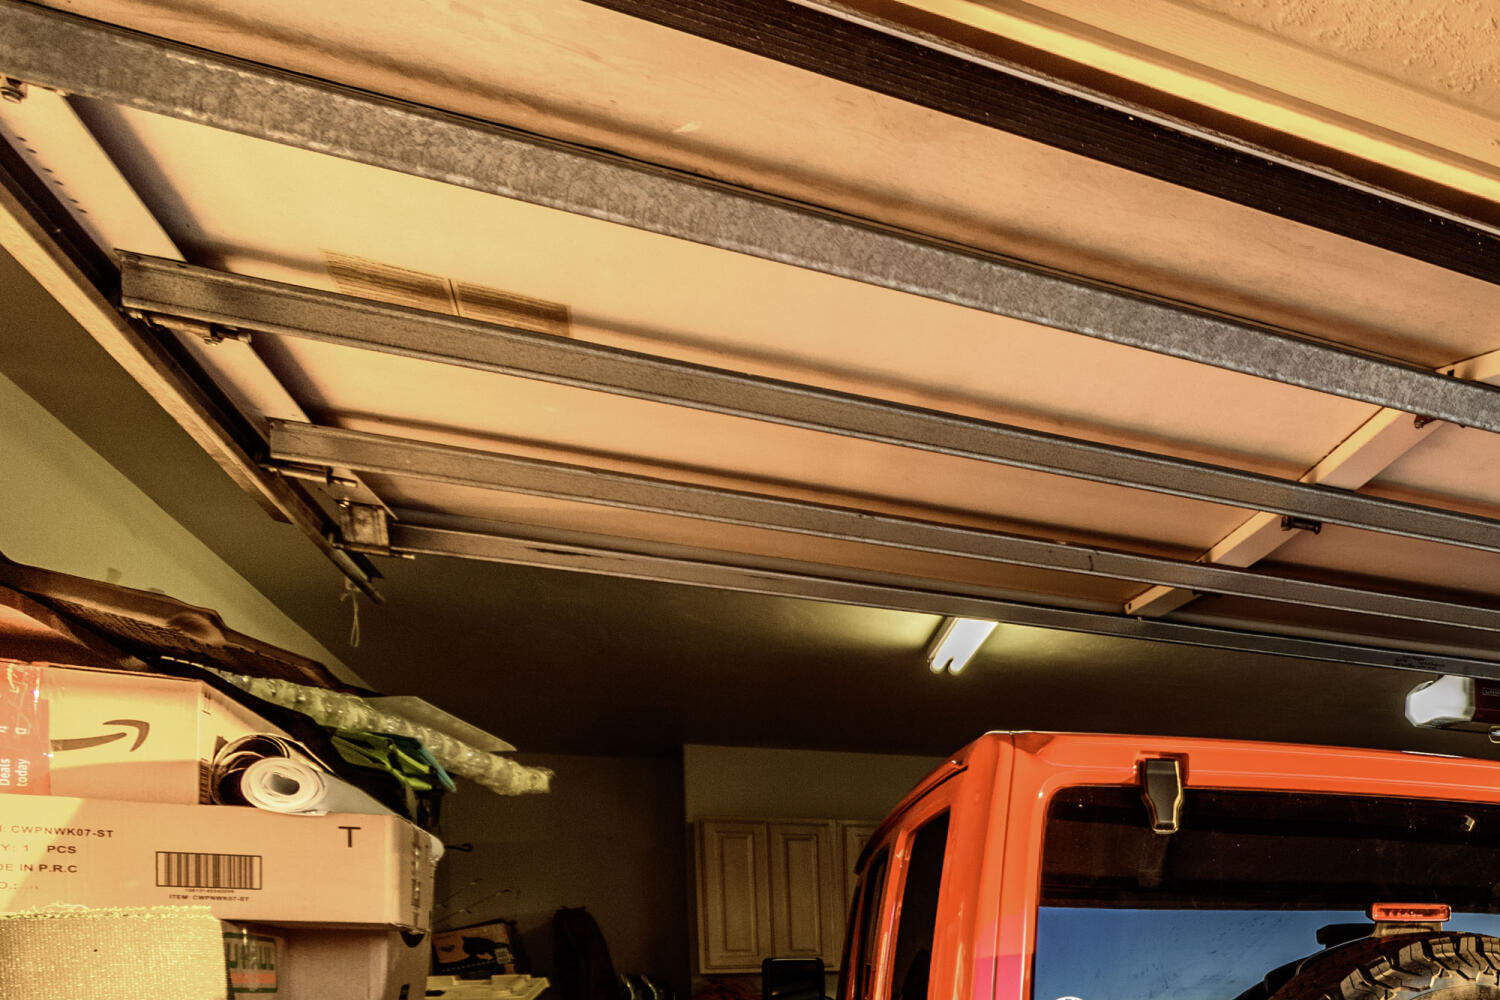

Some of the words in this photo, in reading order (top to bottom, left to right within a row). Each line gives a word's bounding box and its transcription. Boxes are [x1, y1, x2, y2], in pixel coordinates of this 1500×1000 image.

[15, 758, 31, 787] today
[11, 825, 114, 838] CWPNWK07-ST
[338, 826, 362, 848] T
[47, 845, 77, 854] PCS
[19, 864, 34, 872] IN
